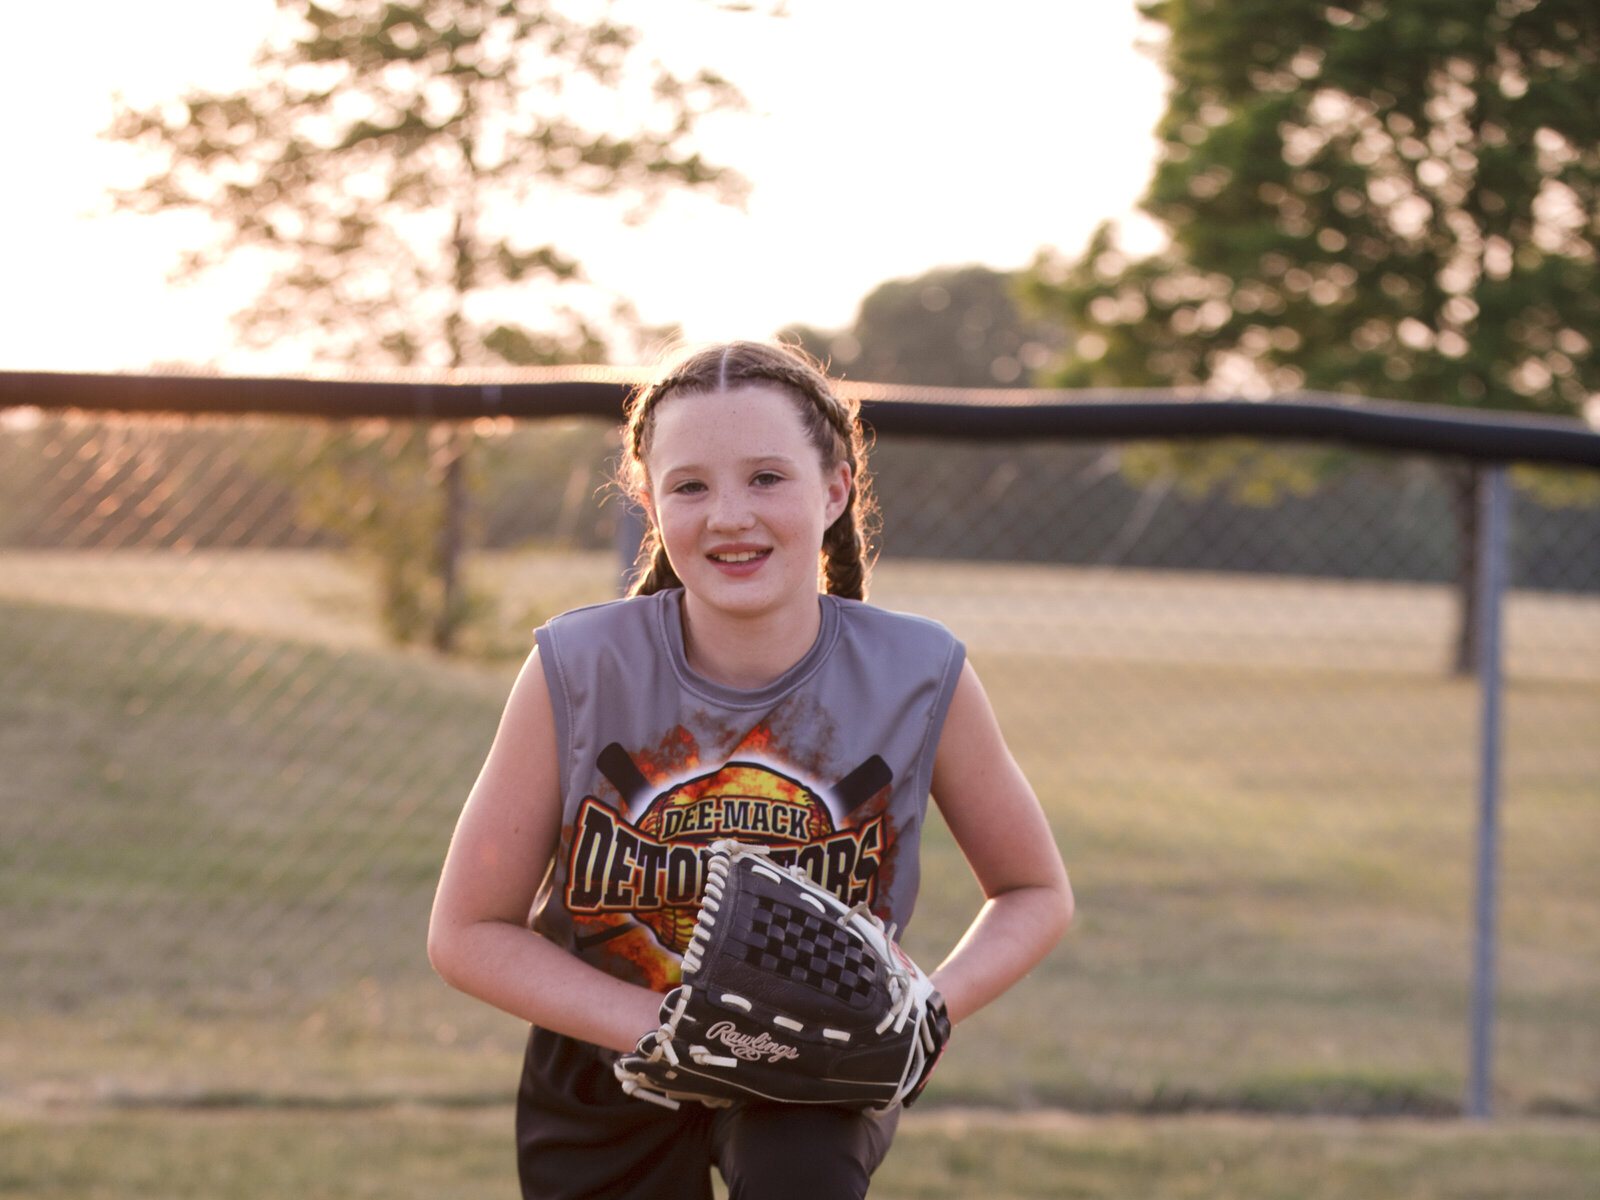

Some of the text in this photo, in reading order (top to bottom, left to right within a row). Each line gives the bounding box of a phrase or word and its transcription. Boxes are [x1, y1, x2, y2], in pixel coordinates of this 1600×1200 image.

[662, 799, 810, 839] DEE-MACK
[568, 802, 882, 910] DETOORS
[706, 1020, 799, 1063] Rawlings
